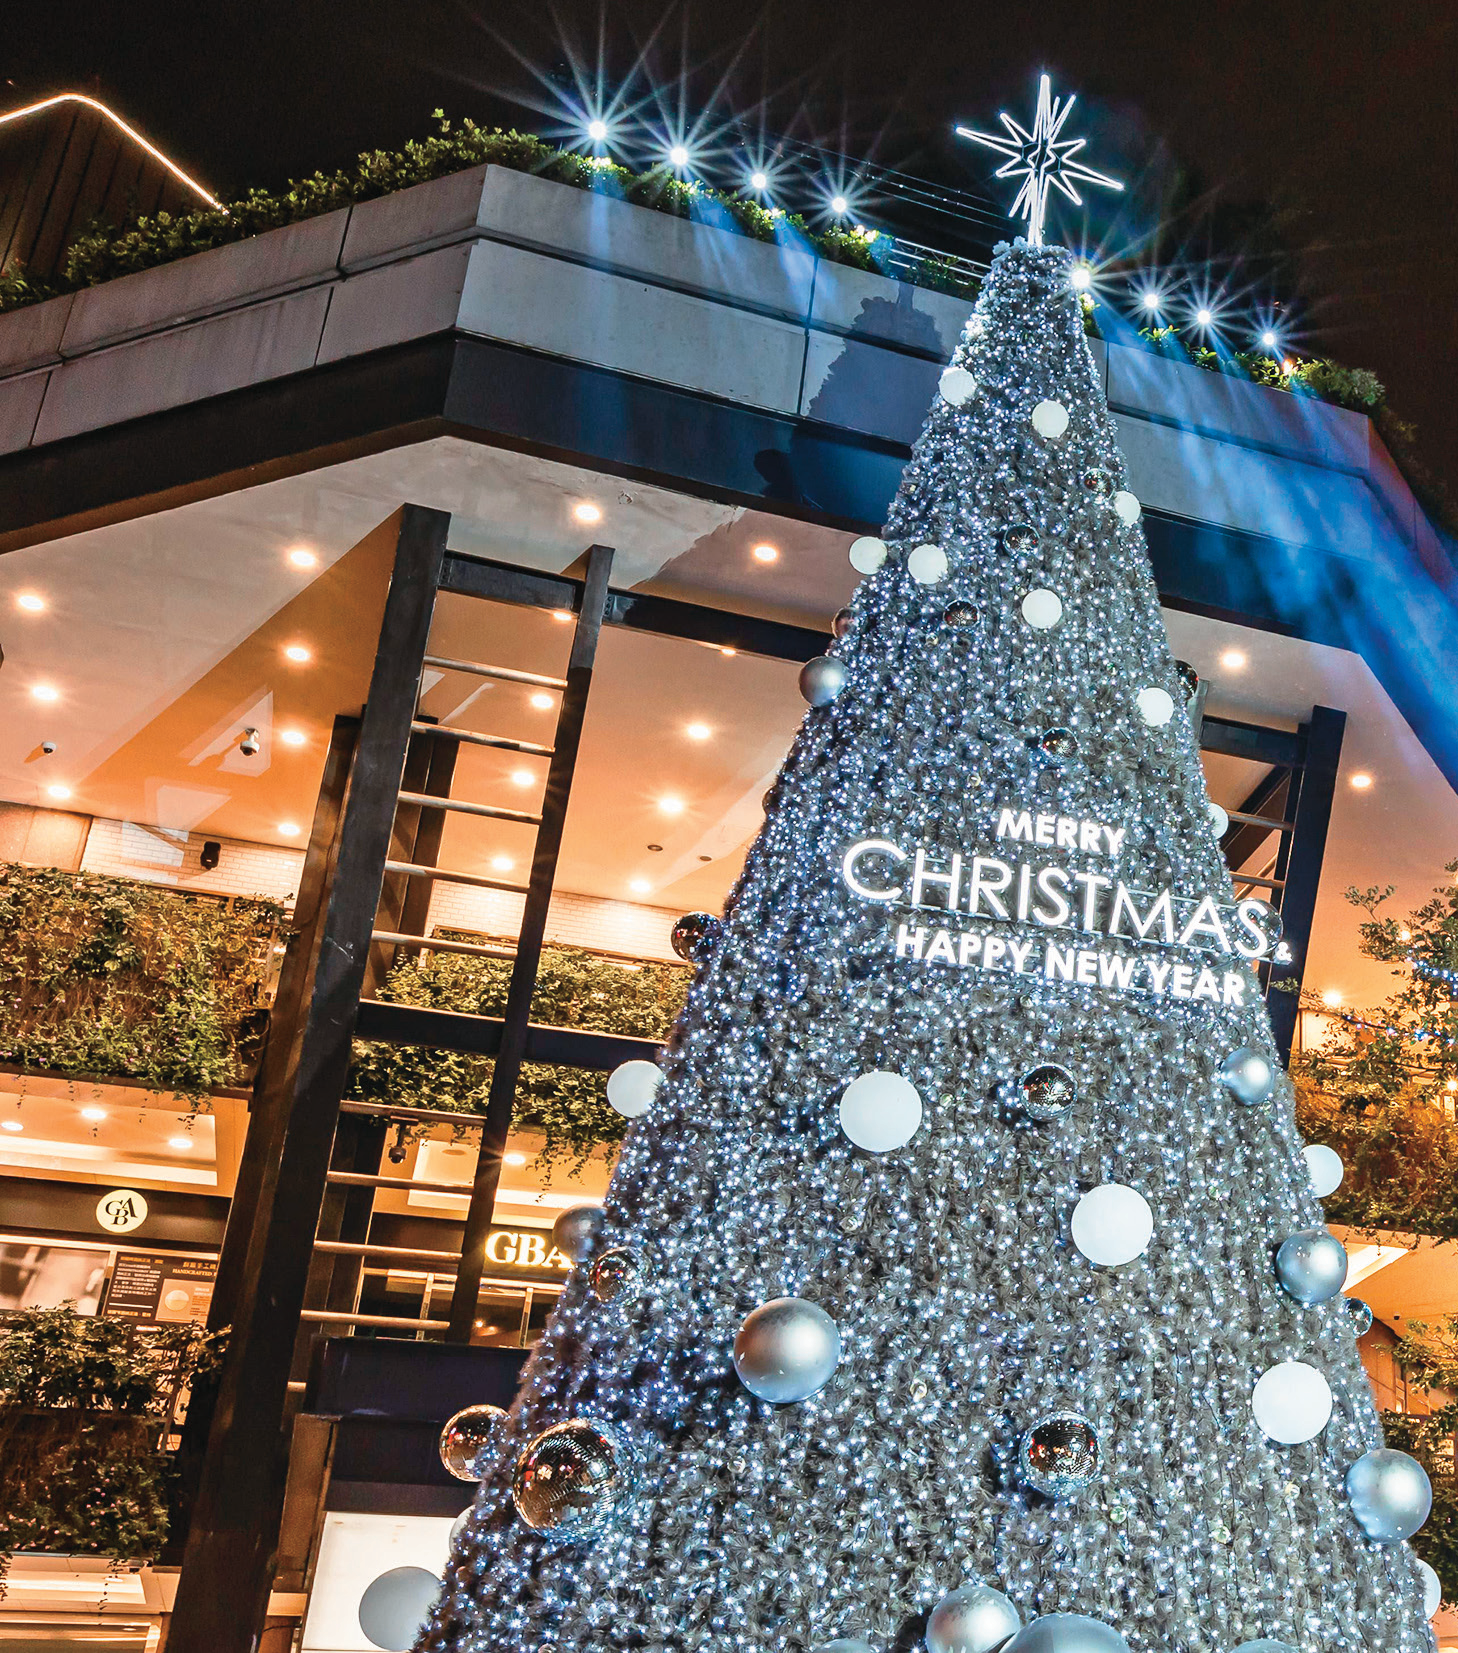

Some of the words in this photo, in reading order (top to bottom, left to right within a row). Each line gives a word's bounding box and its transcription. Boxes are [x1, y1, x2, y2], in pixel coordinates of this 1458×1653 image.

[997, 809, 1127, 857] MERRY
[842, 839, 1270, 958] CHRISTMAS
[1275, 942, 1293, 962] &
[897, 924, 1033, 968] HAPPY
[1045, 948, 1138, 988] NEW
[1148, 962, 1246, 1006] YEAR
[172, 1268, 213, 1277] HANDCRAFTED
[484, 1231, 575, 1268] GBA
